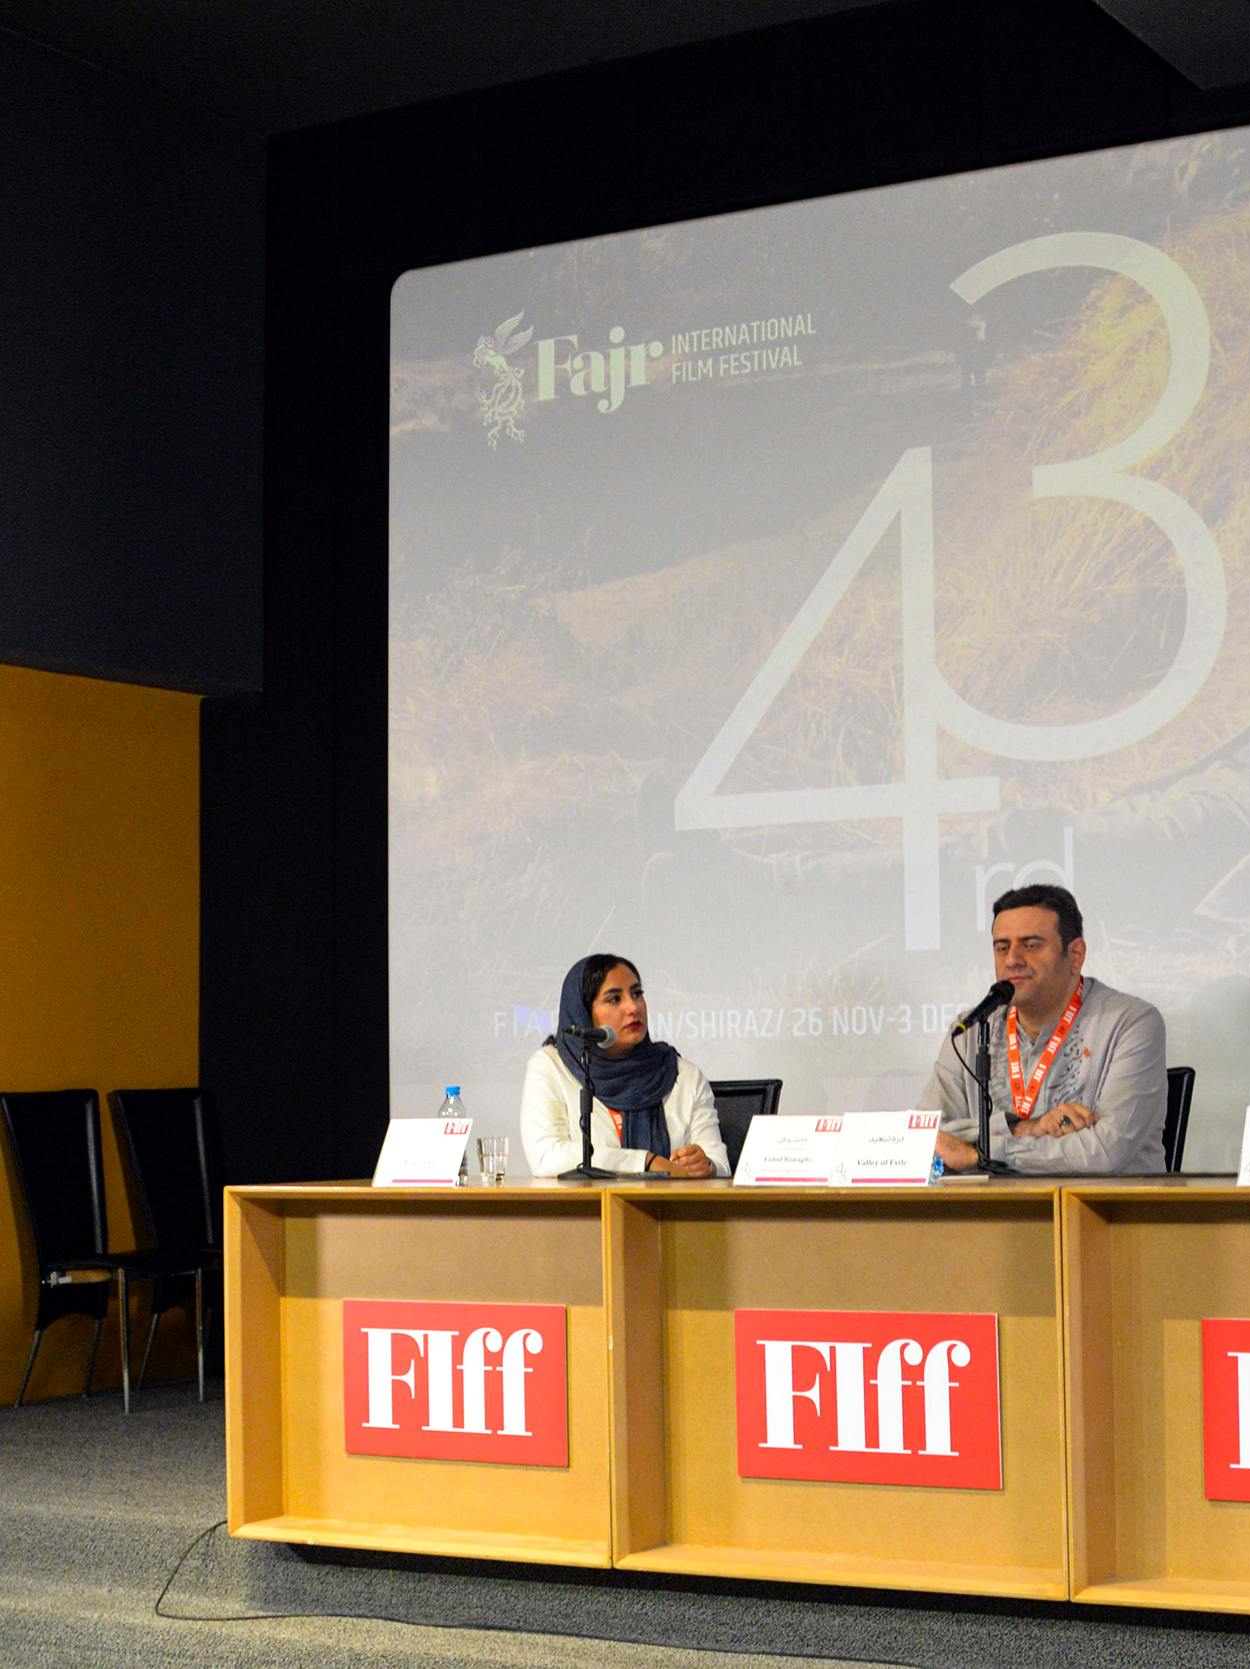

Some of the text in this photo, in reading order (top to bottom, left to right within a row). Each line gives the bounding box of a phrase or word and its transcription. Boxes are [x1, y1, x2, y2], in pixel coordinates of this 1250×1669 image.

[672, 313, 817, 355] INTERNATIONAL
[534, 326, 664, 414] Fajr
[672, 345, 803, 384] FILM FESTIVAL
[792, 1007, 823, 1036] 26
[832, 1004, 912, 1035] NOV-3
[857, 1158, 909, 1168] Valley of Exile
[361, 1326, 544, 1437] FIff
[756, 1338, 972, 1457] FIff
